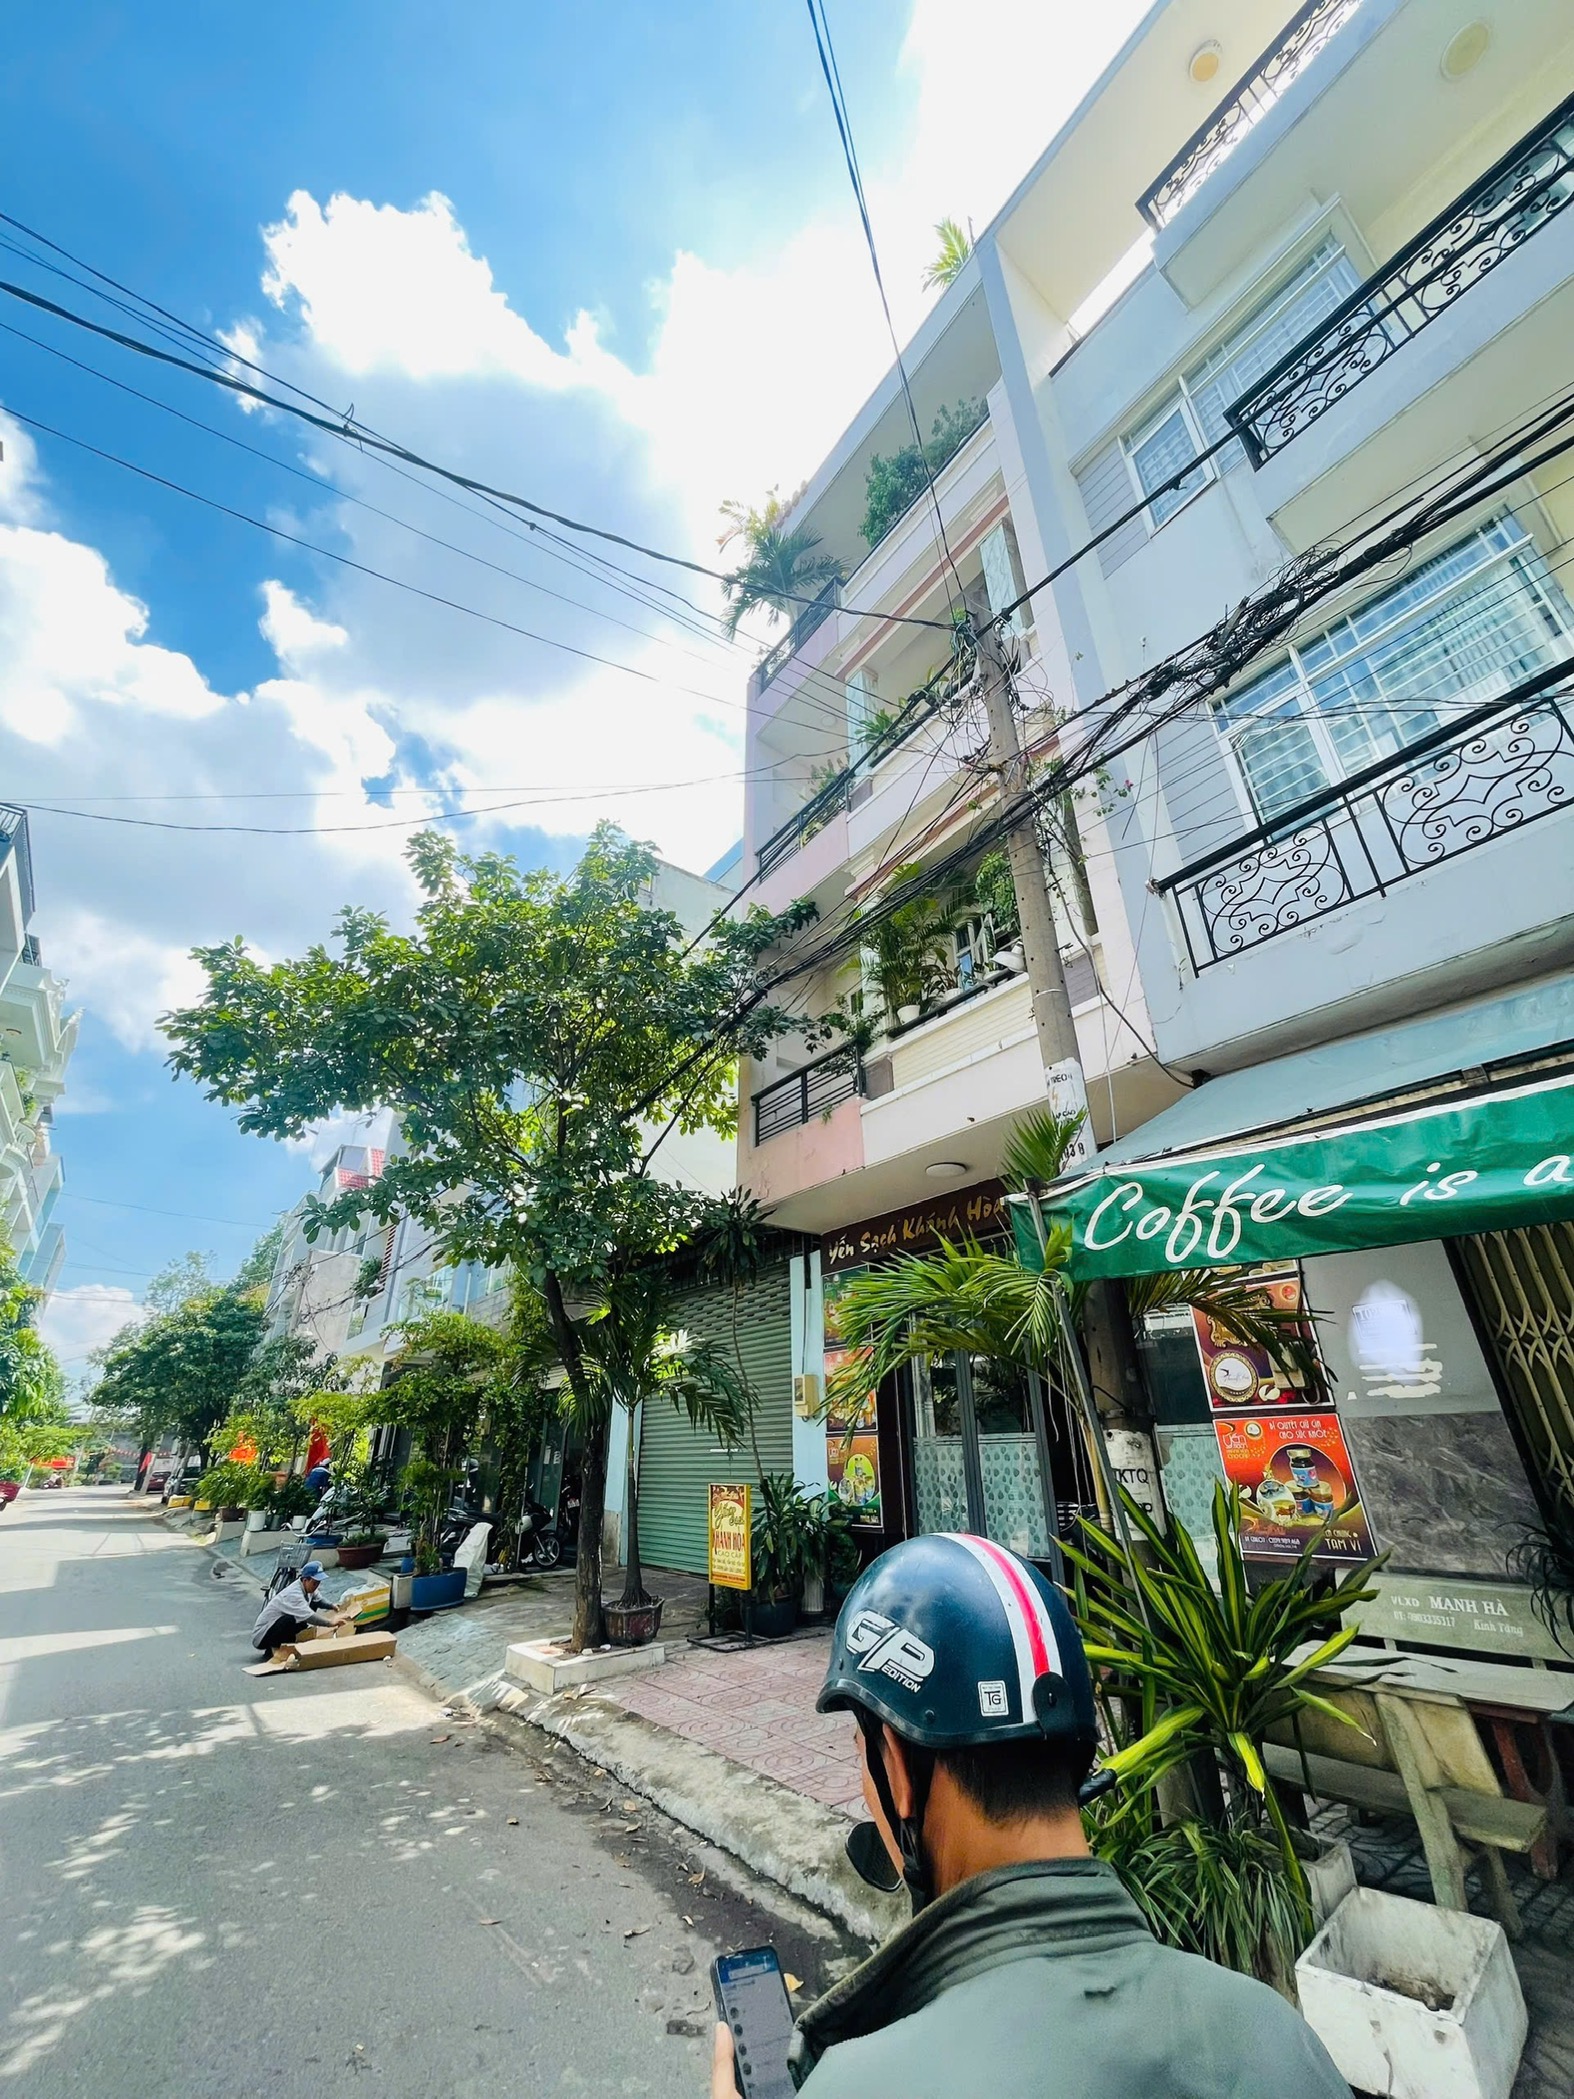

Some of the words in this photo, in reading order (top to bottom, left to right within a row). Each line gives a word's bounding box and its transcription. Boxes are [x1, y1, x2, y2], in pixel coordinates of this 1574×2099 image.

[1084, 1163, 1353, 1263] Coffee
[1400, 1162, 1478, 1206] is
[829, 1233, 855, 1265] Yến
[860, 1224, 897, 1254] Sạch
[902, 1206, 958, 1241] Khánh
[967, 1195, 1004, 1221] Hòa
[1325, 1538, 1348, 1551] TAM
[1428, 1596, 1479, 1614] MẠNH
[1482, 1598, 1510, 1617] HÀ
[846, 1609, 935, 1683] GP
[880, 1665, 922, 1694] EDITION
[984, 1690, 1002, 1706] TG
